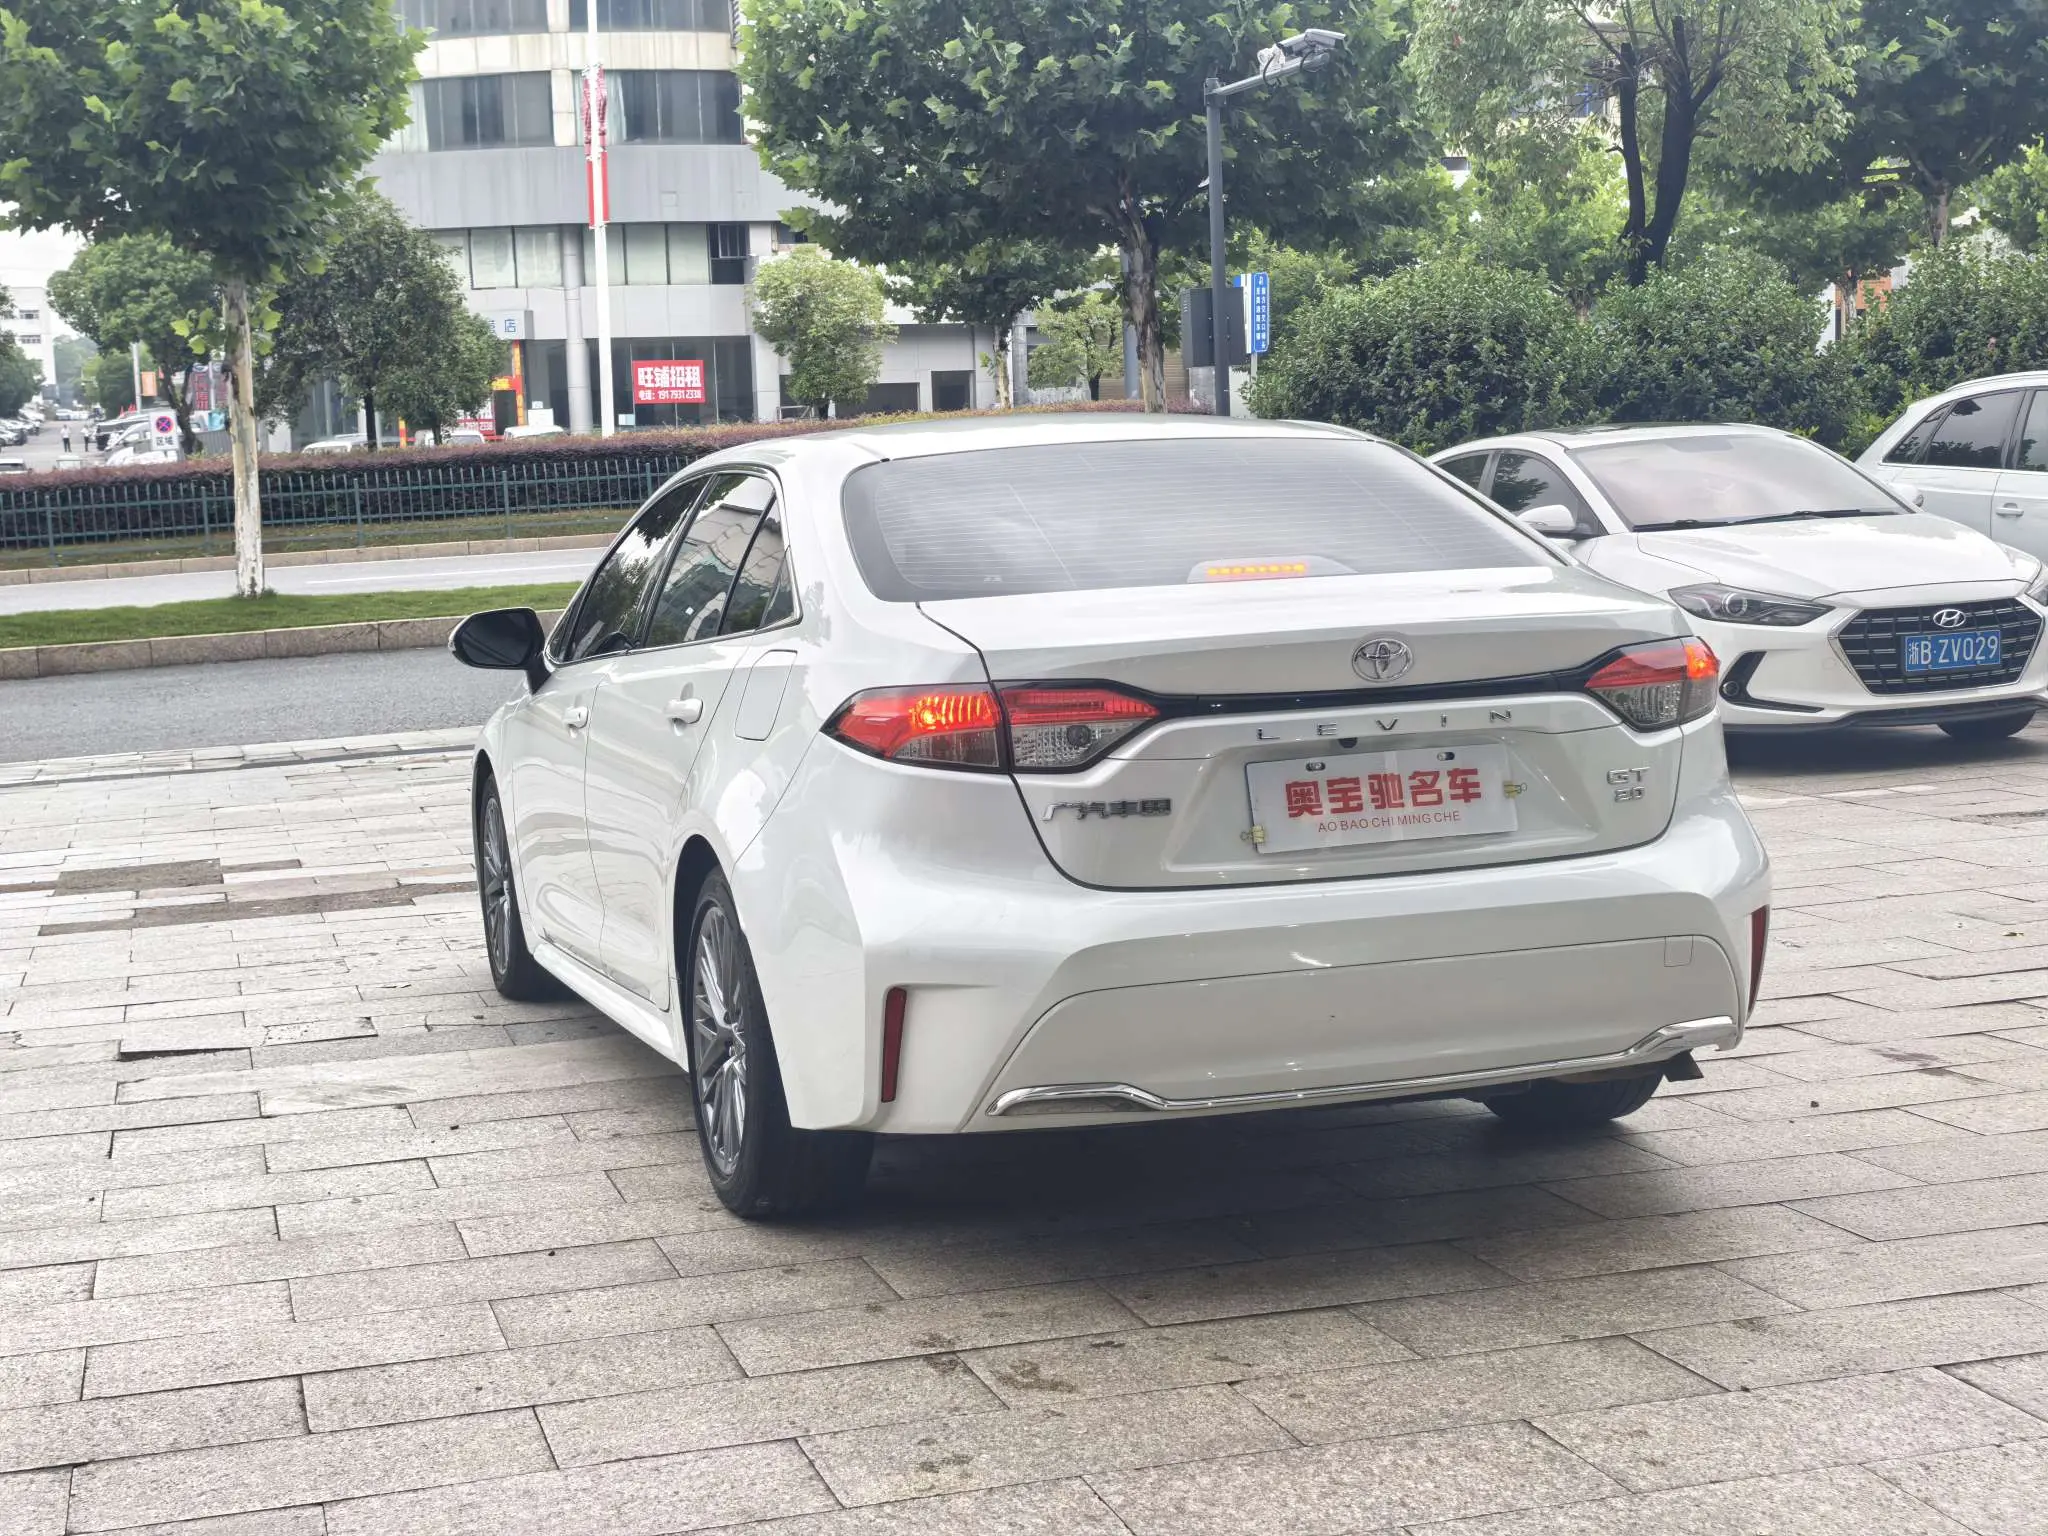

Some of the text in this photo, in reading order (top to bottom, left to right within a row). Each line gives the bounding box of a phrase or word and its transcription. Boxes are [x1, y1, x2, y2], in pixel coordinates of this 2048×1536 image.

[638, 366, 702, 388] 旺铺招租
[156, 436, 174, 446] 区域
[1257, 709, 1512, 740] LEVIN
[1285, 767, 1482, 818] 奥宝驰名车
[1318, 810, 1461, 833] AO BAO CHI MING CHE
